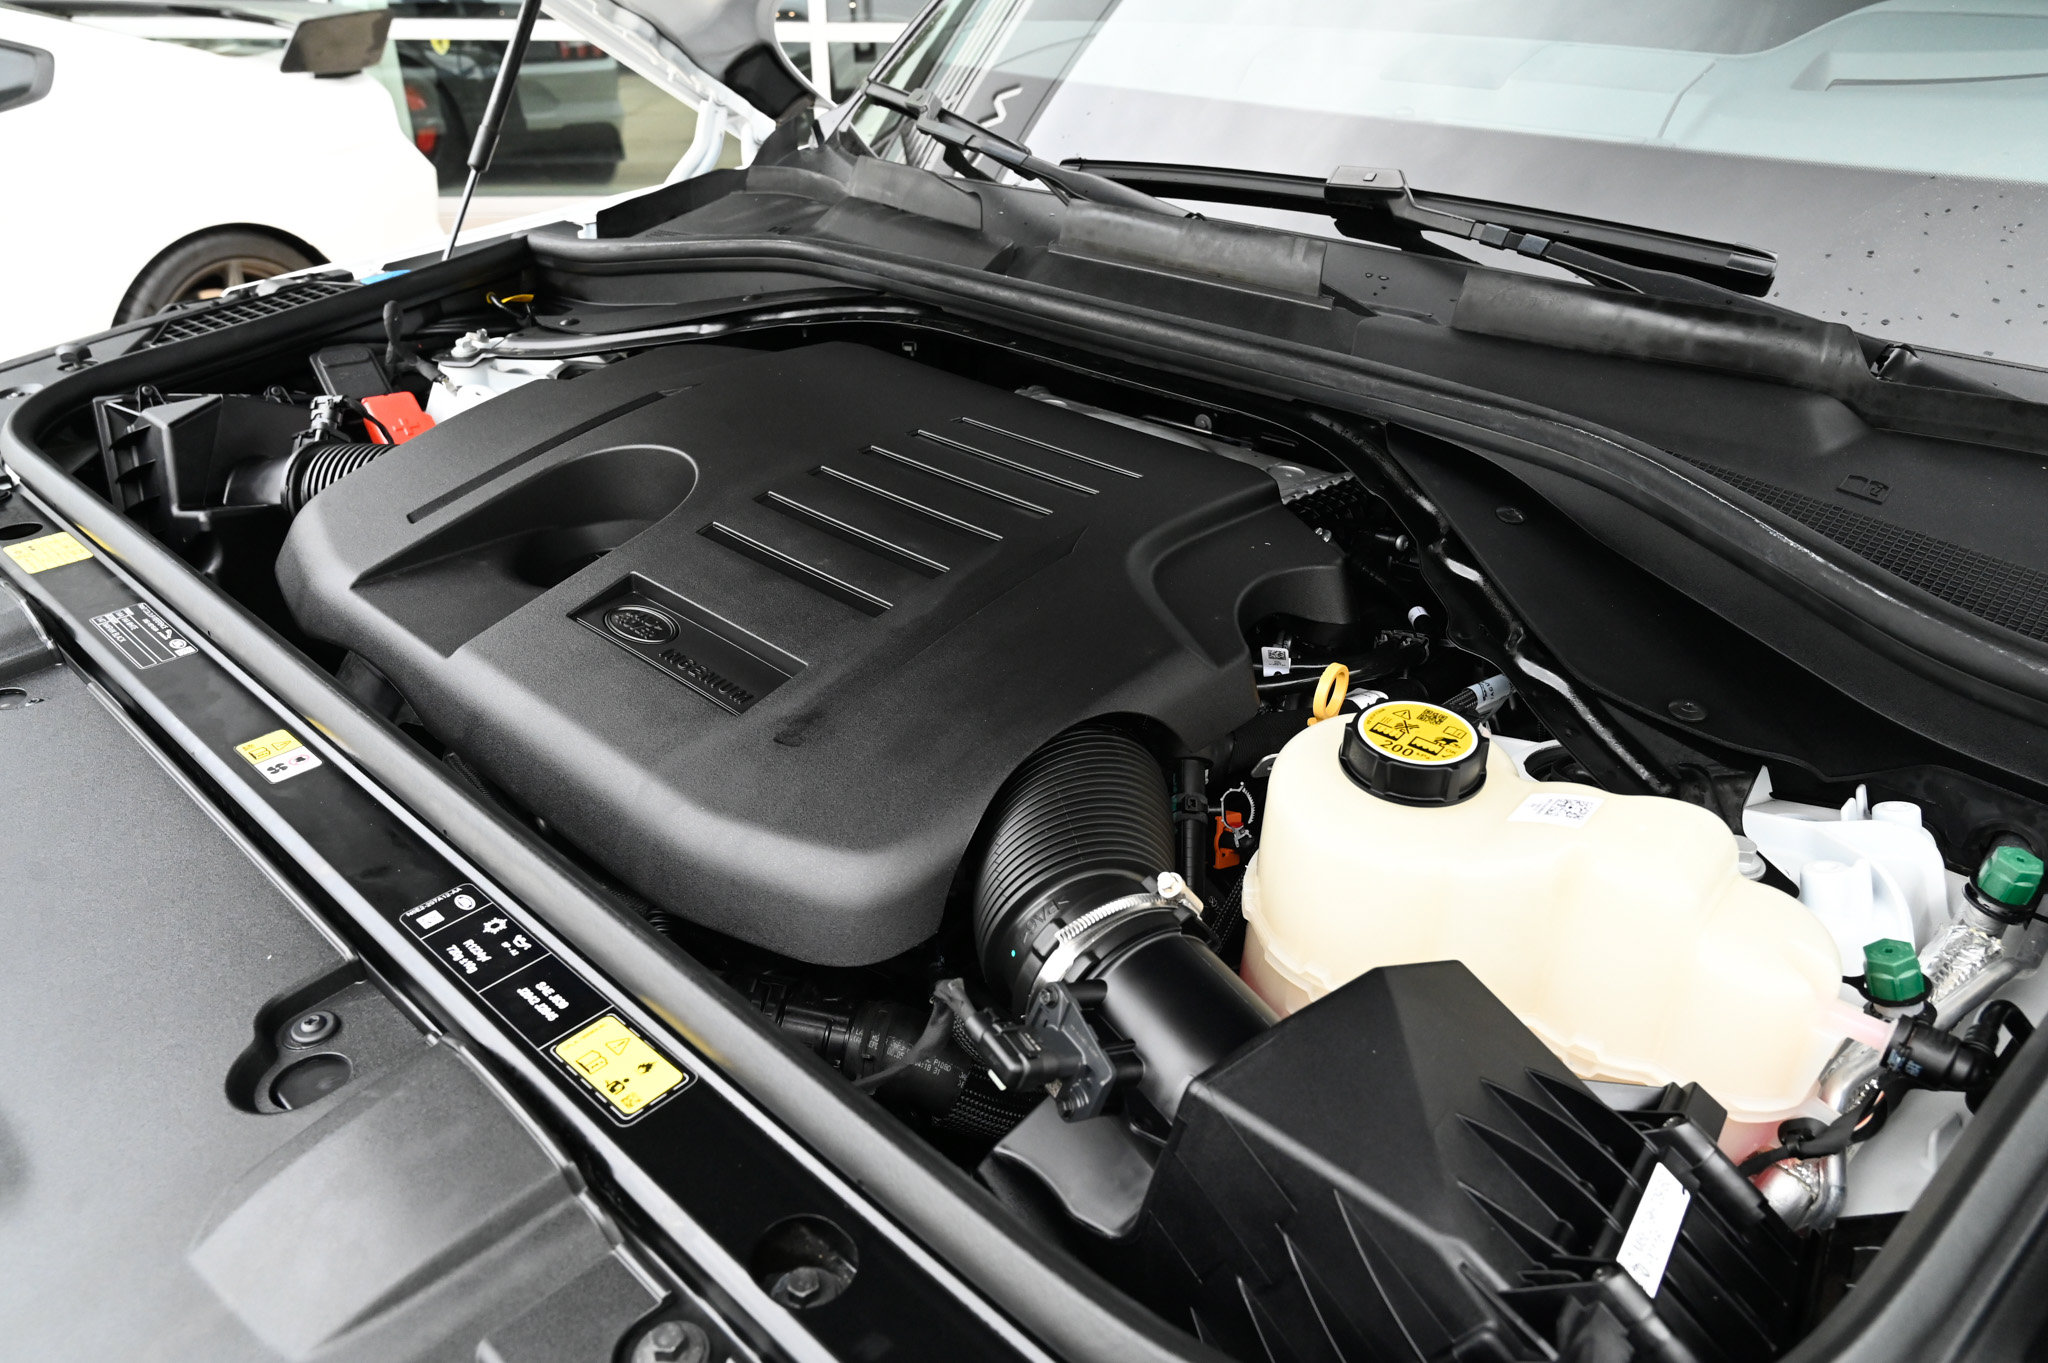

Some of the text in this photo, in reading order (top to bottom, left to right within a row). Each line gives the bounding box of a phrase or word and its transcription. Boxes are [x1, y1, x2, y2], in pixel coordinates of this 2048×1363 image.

[658, 648, 755, 705] INGENIUM
[1379, 739, 1414, 757] 200
[535, 981, 556, 997] SAE
